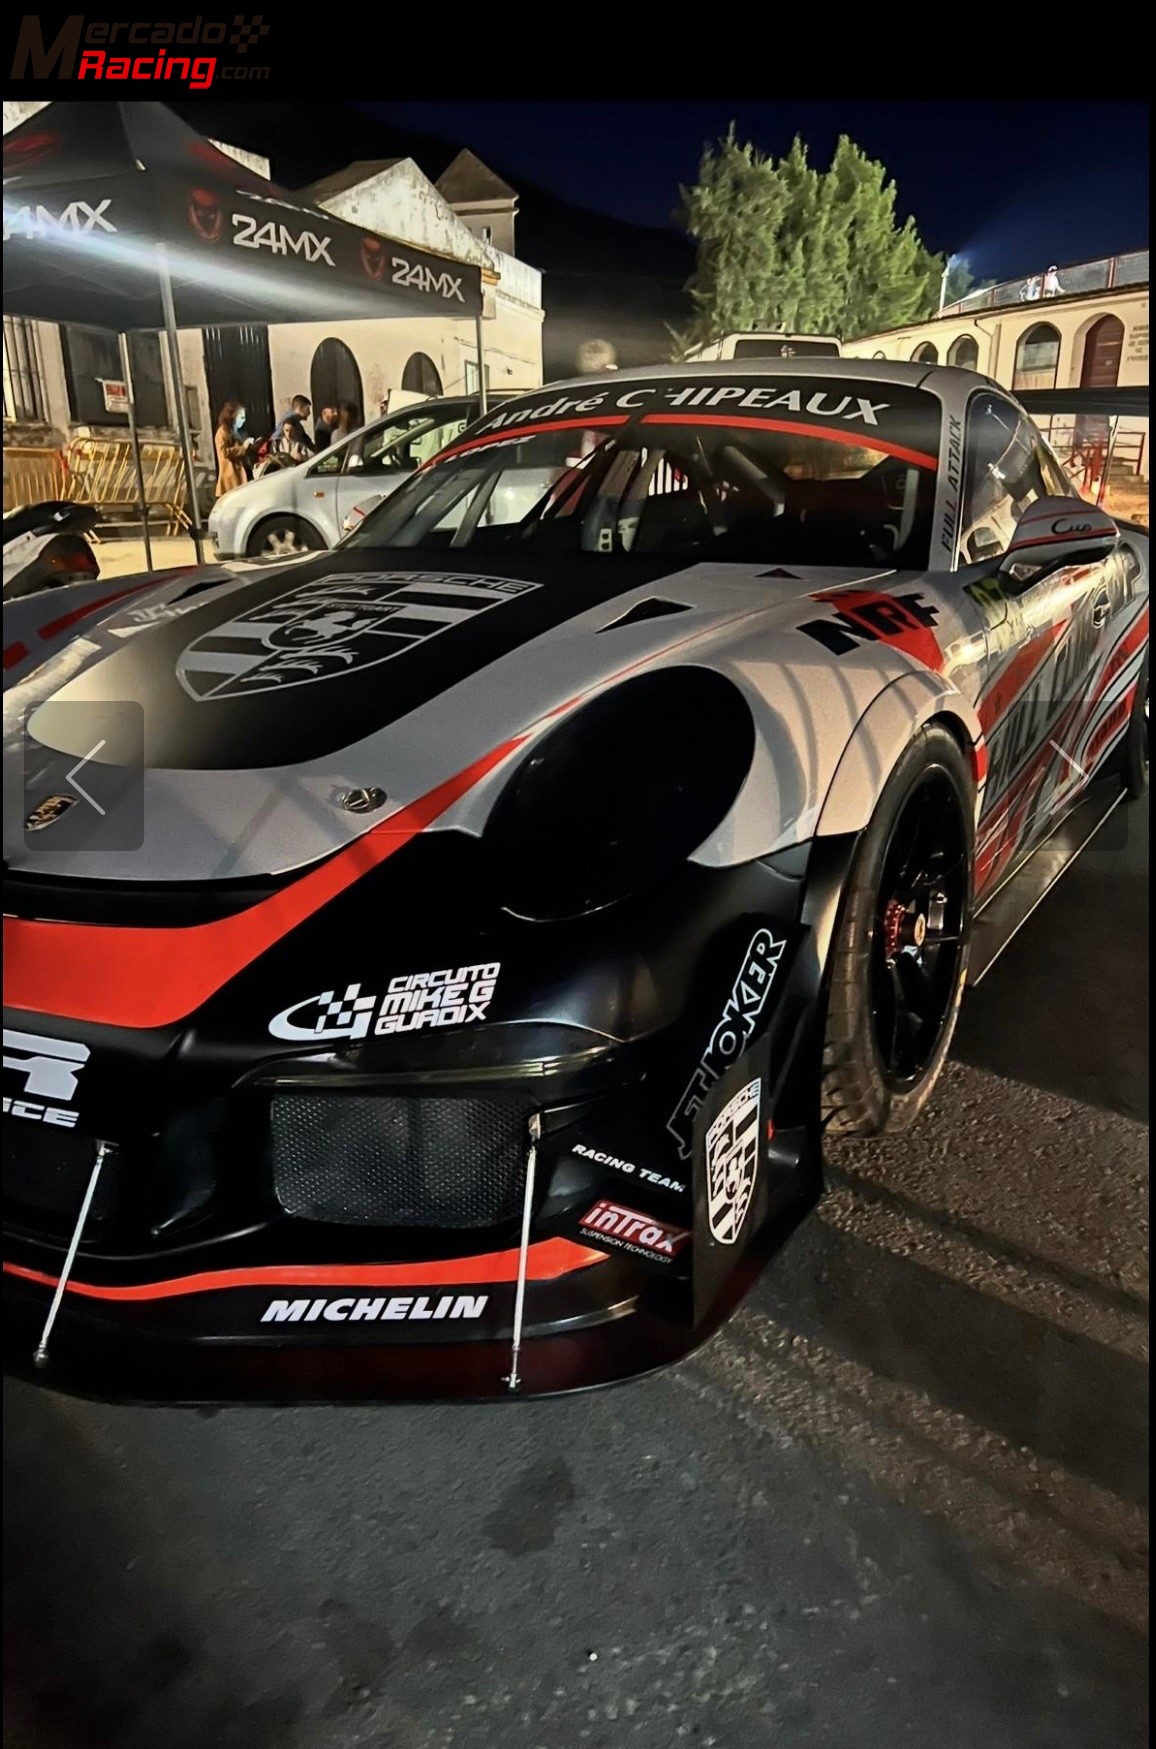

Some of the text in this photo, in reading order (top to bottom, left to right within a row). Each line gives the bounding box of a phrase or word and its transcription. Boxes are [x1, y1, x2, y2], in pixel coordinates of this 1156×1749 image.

[3, 199, 118, 241] 4MX
[232, 214, 335, 266] 24MX
[392, 257, 465, 303] 24MX
[475, 391, 609, 435] André
[947, 414, 962, 493] ATTACK
[1051, 517, 1092, 536] Cup
[379, 979, 497, 1017] MIKE G
[388, 962, 501, 993] CIRCUITO
[374, 1001, 491, 1035] GUADIX
[571, 1144, 686, 1192] RACING TEAM
[261, 1296, 488, 1323] MICHELIN
